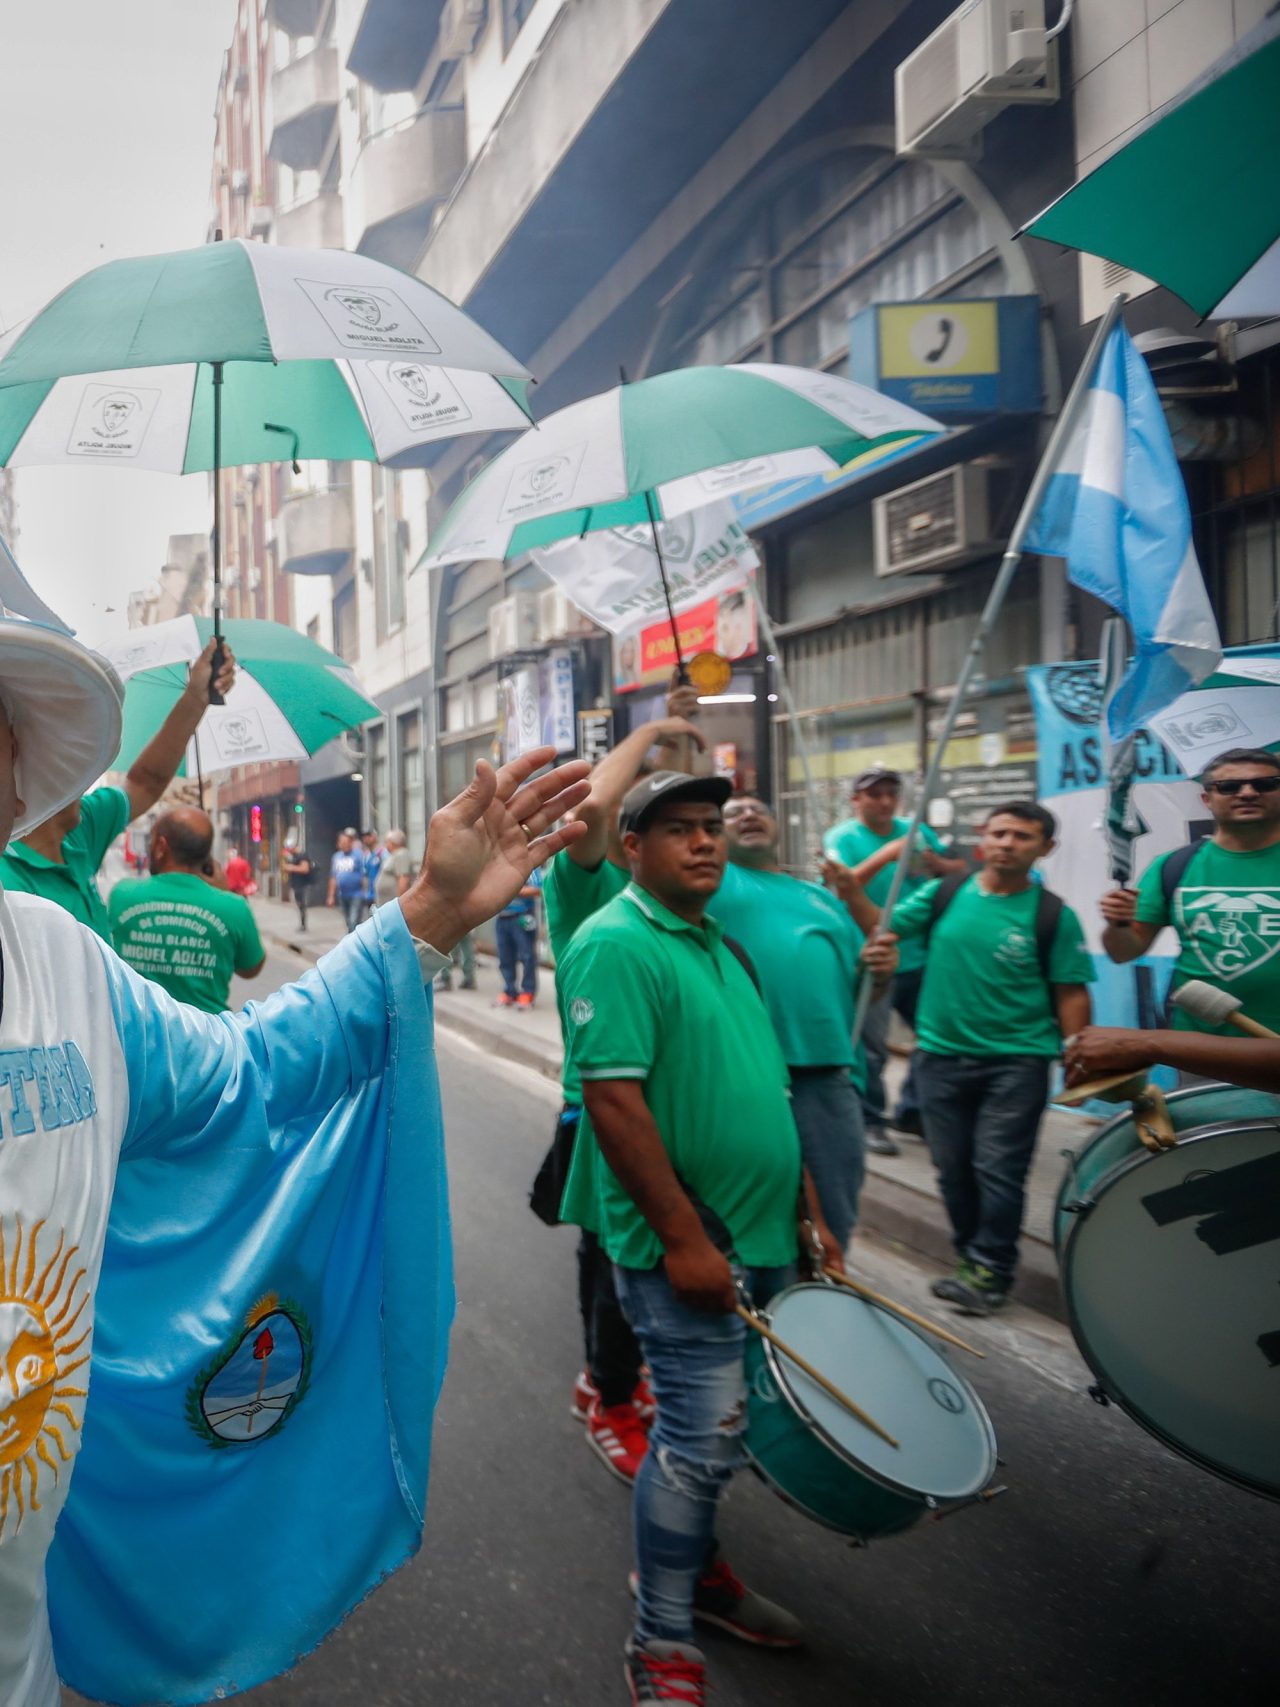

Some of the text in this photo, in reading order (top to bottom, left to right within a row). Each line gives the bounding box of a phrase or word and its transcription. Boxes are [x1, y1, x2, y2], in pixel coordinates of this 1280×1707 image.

[153, 915, 207, 936] COMERCIO
[165, 934, 212, 950] BLANCA
[121, 943, 168, 963] MIGUEL
